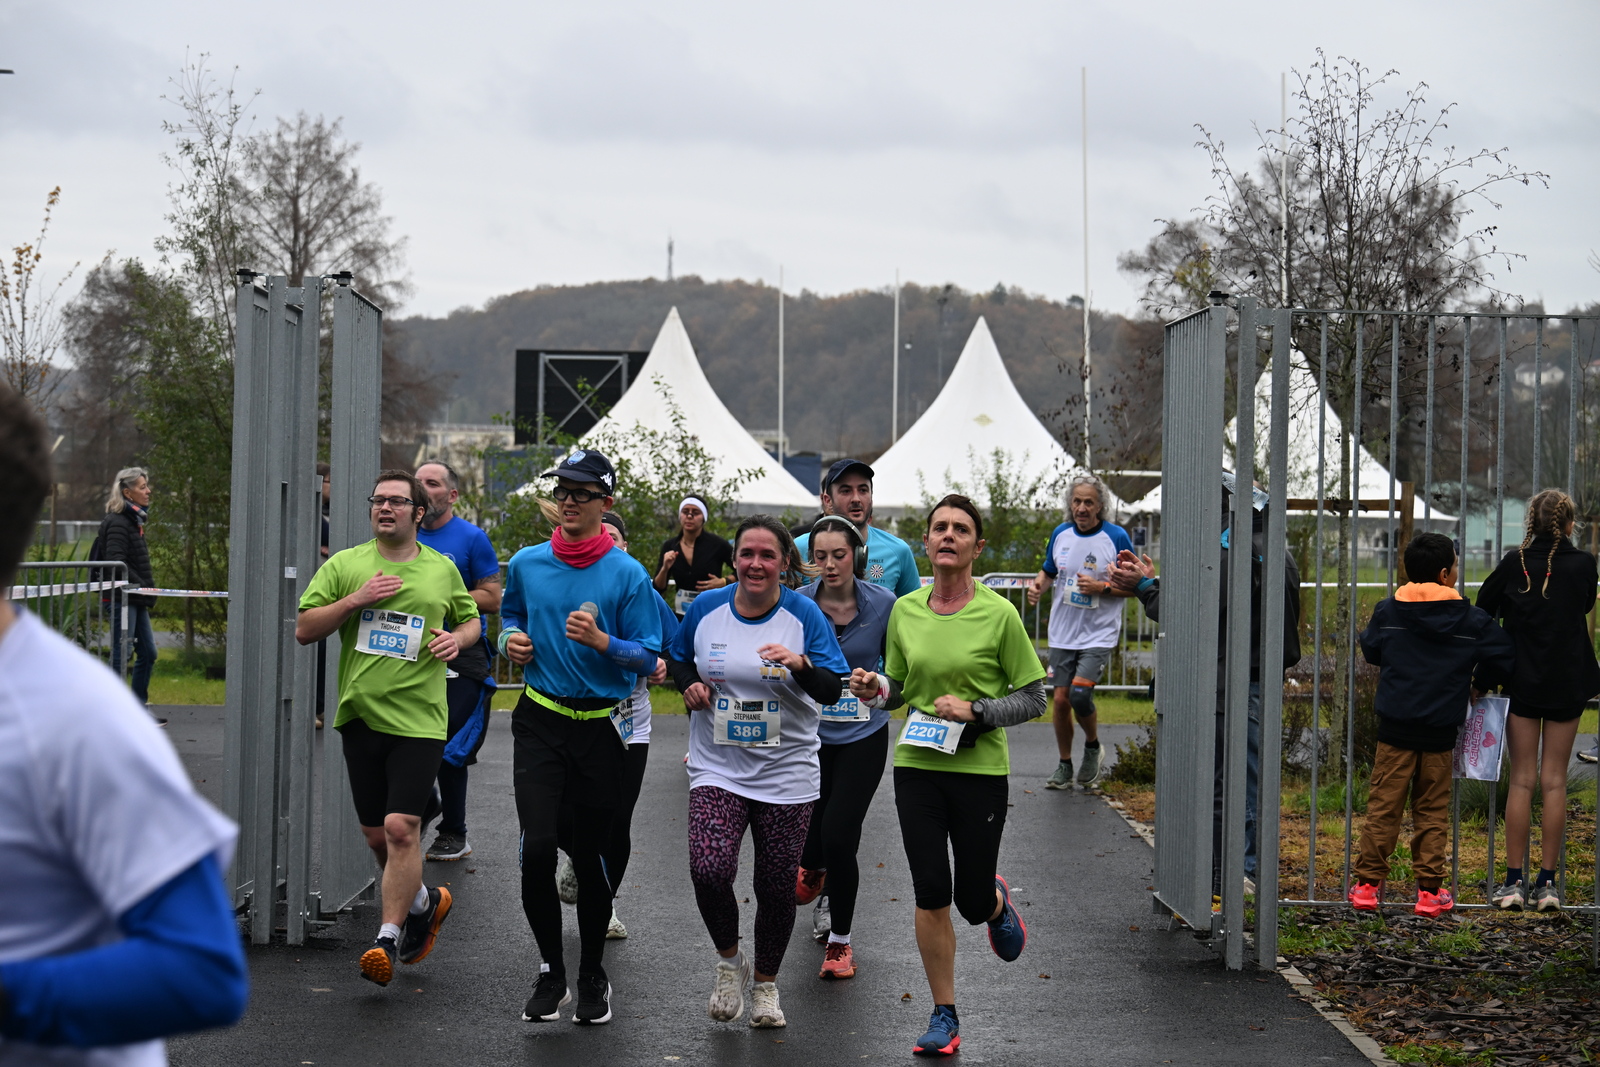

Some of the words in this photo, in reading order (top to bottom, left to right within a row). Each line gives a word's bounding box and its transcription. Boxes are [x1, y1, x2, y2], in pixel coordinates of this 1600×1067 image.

[1073, 594, 1089, 604] 730
[381, 622, 401, 633] THOMAS
[371, 634, 407, 649] 1593
[823, 701, 858, 713] 2545
[733, 712, 762, 721] STEPHANIE
[920, 715, 943, 724] CHANTAL
[733, 724, 762, 738] 386
[1465, 719, 1473, 731] LA
[908, 725, 946, 740] 2201
[1469, 716, 1483, 766] MEILLEURE
